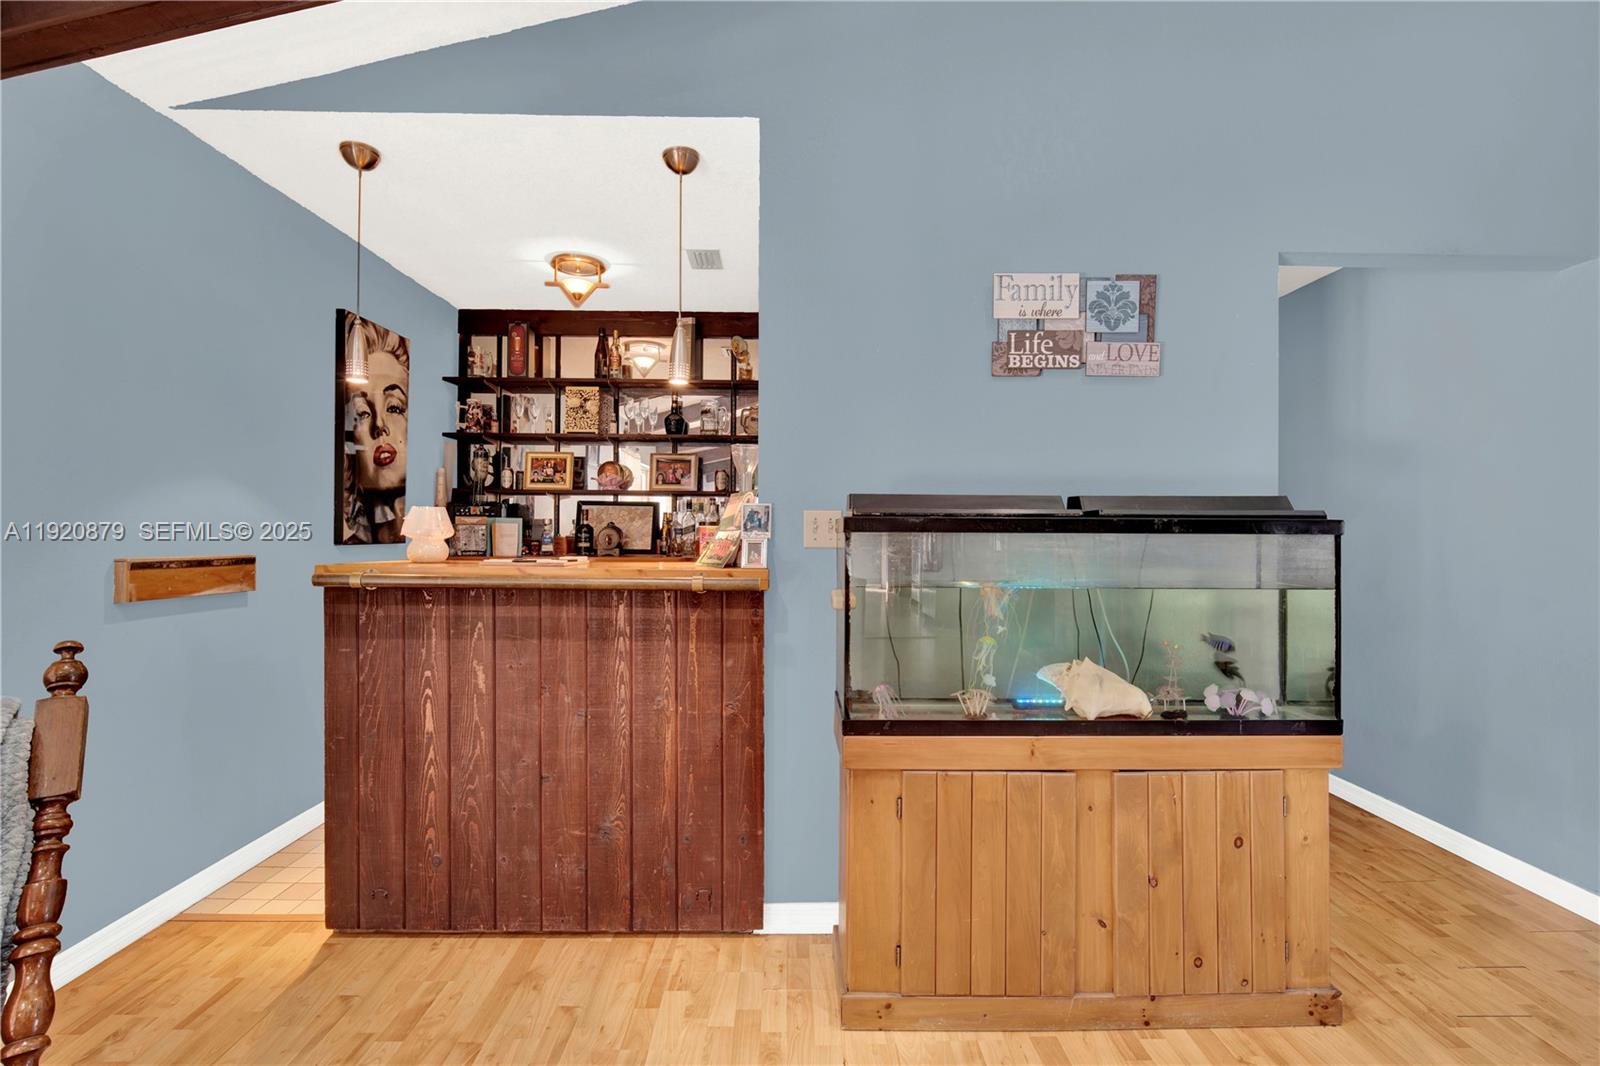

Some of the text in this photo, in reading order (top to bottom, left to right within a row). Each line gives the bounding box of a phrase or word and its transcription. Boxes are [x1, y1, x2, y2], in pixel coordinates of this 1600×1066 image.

[995, 274, 1078, 309] Family
[1018, 302, 1063, 317] is where
[1008, 331, 1053, 355] Life
[1107, 343, 1160, 361] LOVE
[1007, 355, 1081, 369] BEGINS
